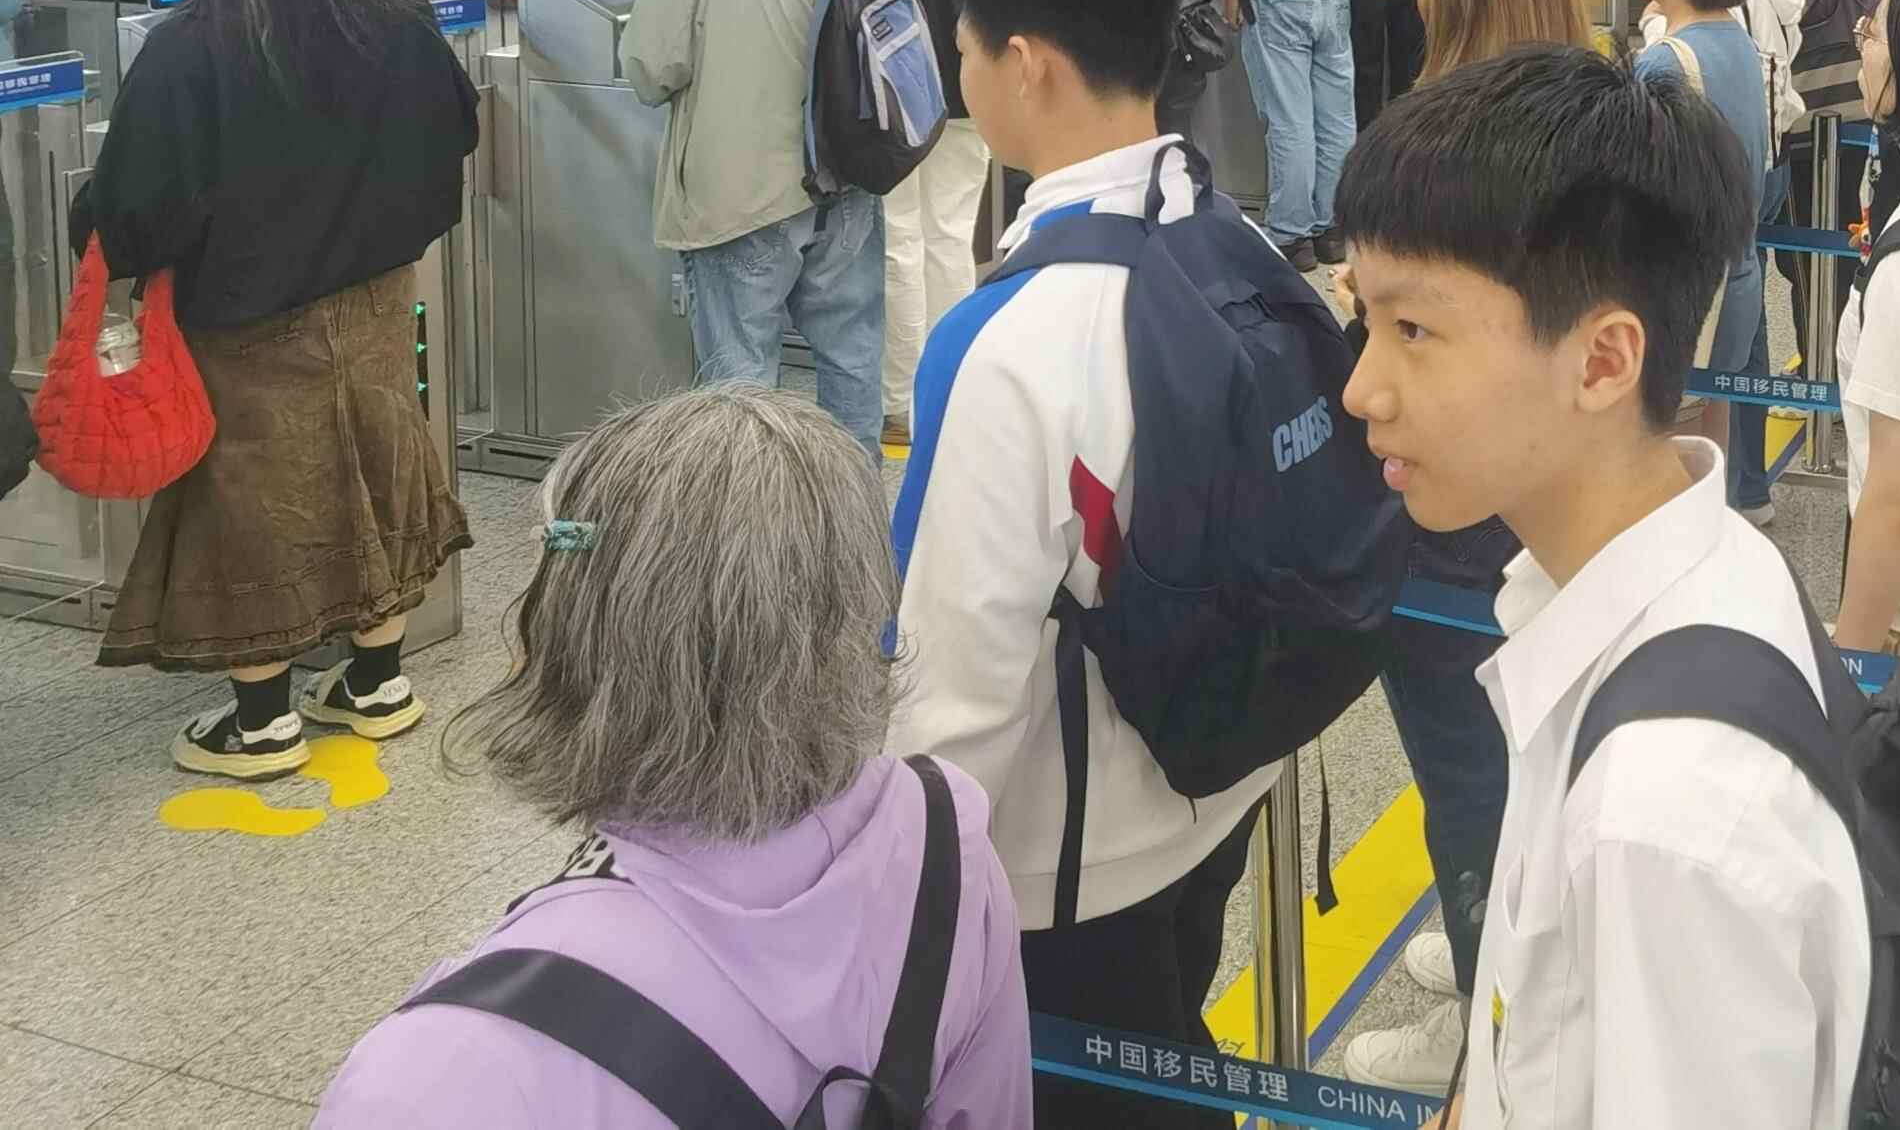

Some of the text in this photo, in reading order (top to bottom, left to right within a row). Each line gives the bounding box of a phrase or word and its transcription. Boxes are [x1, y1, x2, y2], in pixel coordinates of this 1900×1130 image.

[1715, 374, 1828, 401] 中国移民管理
[1085, 1034, 1289, 1103] 中国移民管理
[1317, 1085, 1406, 1122] CHINA
